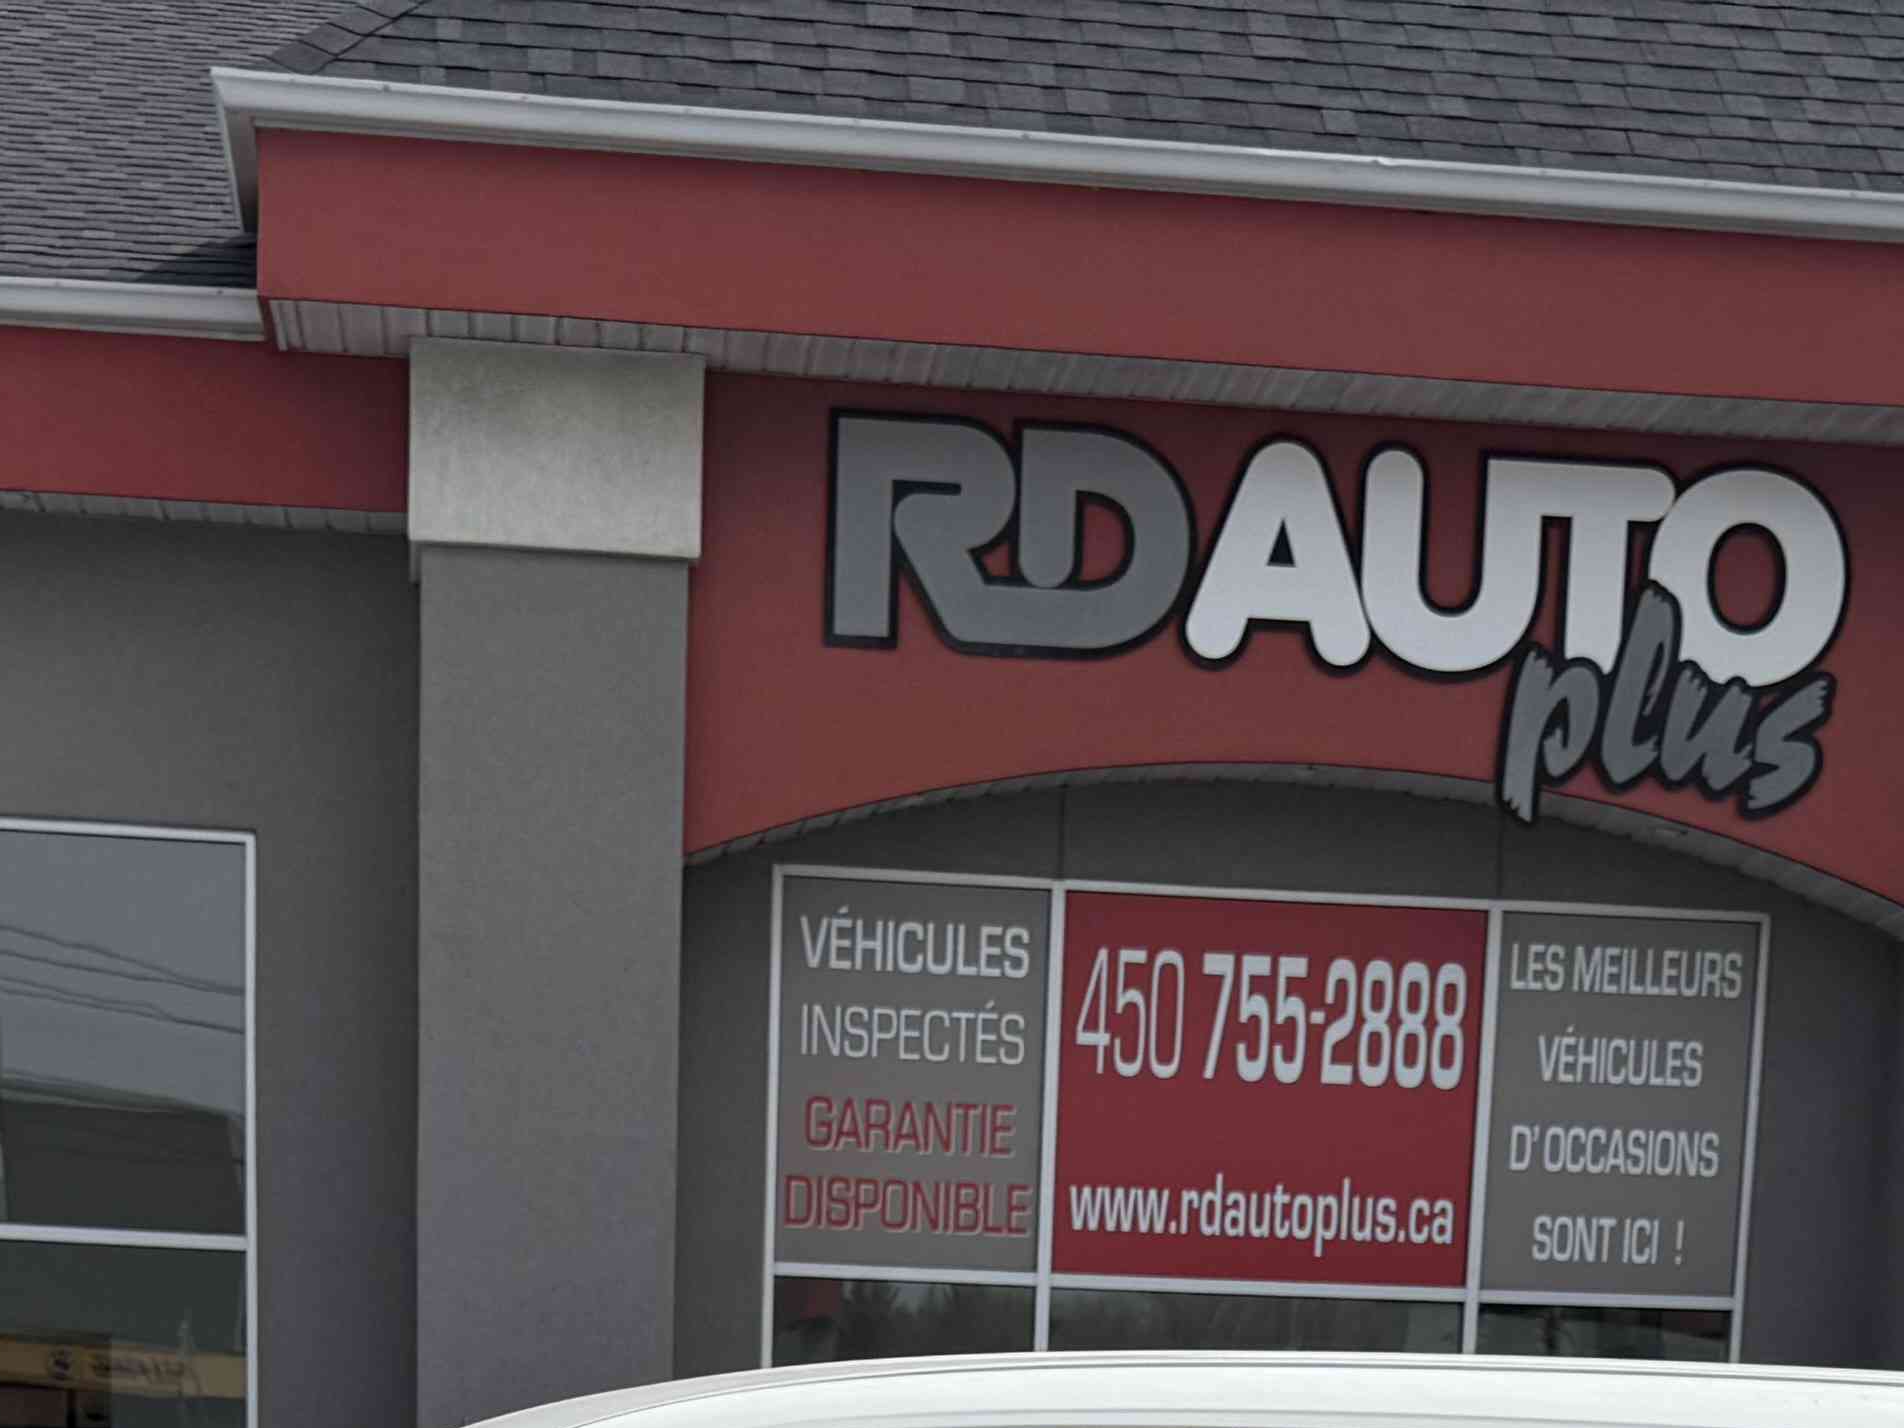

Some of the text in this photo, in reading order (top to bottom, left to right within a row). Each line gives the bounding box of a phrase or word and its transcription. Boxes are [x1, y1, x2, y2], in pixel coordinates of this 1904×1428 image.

[1504, 582, 1831, 819] plus
[800, 905, 1031, 979] VÉHICULES
[1509, 943, 1742, 999] LES MEILLEURS
[800, 1000, 1026, 1066] INSPECTÉS
[1075, 946, 1468, 1091] 450 755-2888
[1538, 1024, 1704, 1088] VÉHICULES
[803, 1096, 1017, 1158] GARANTIE
[783, 1174, 1034, 1238] DISPONIBLE
[1069, 1172, 1455, 1258] www.rdautoplus.ca
[1531, 1214, 1617, 1264] SONT
[1621, 1217, 1660, 1266] ICI
